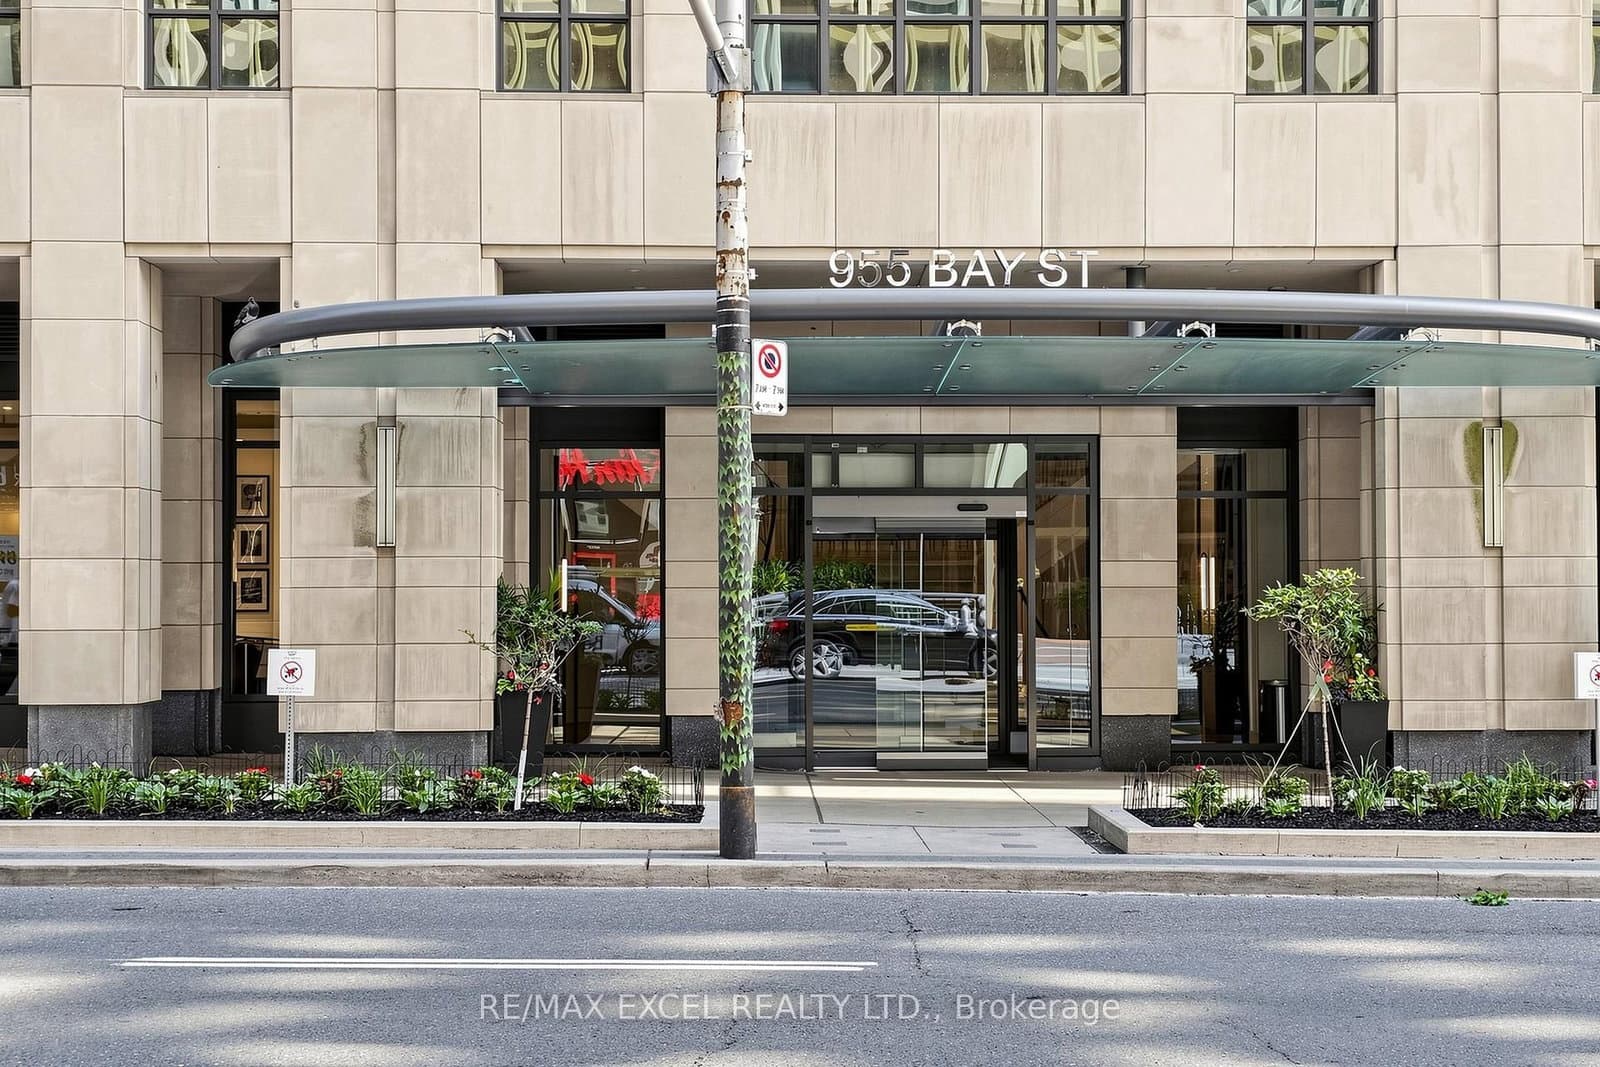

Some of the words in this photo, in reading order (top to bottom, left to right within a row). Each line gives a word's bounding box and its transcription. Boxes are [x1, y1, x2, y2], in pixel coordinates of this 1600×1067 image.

[829, 249, 912, 287] 955
[929, 249, 1026, 287] BAY
[1037, 249, 1099, 287] ST
